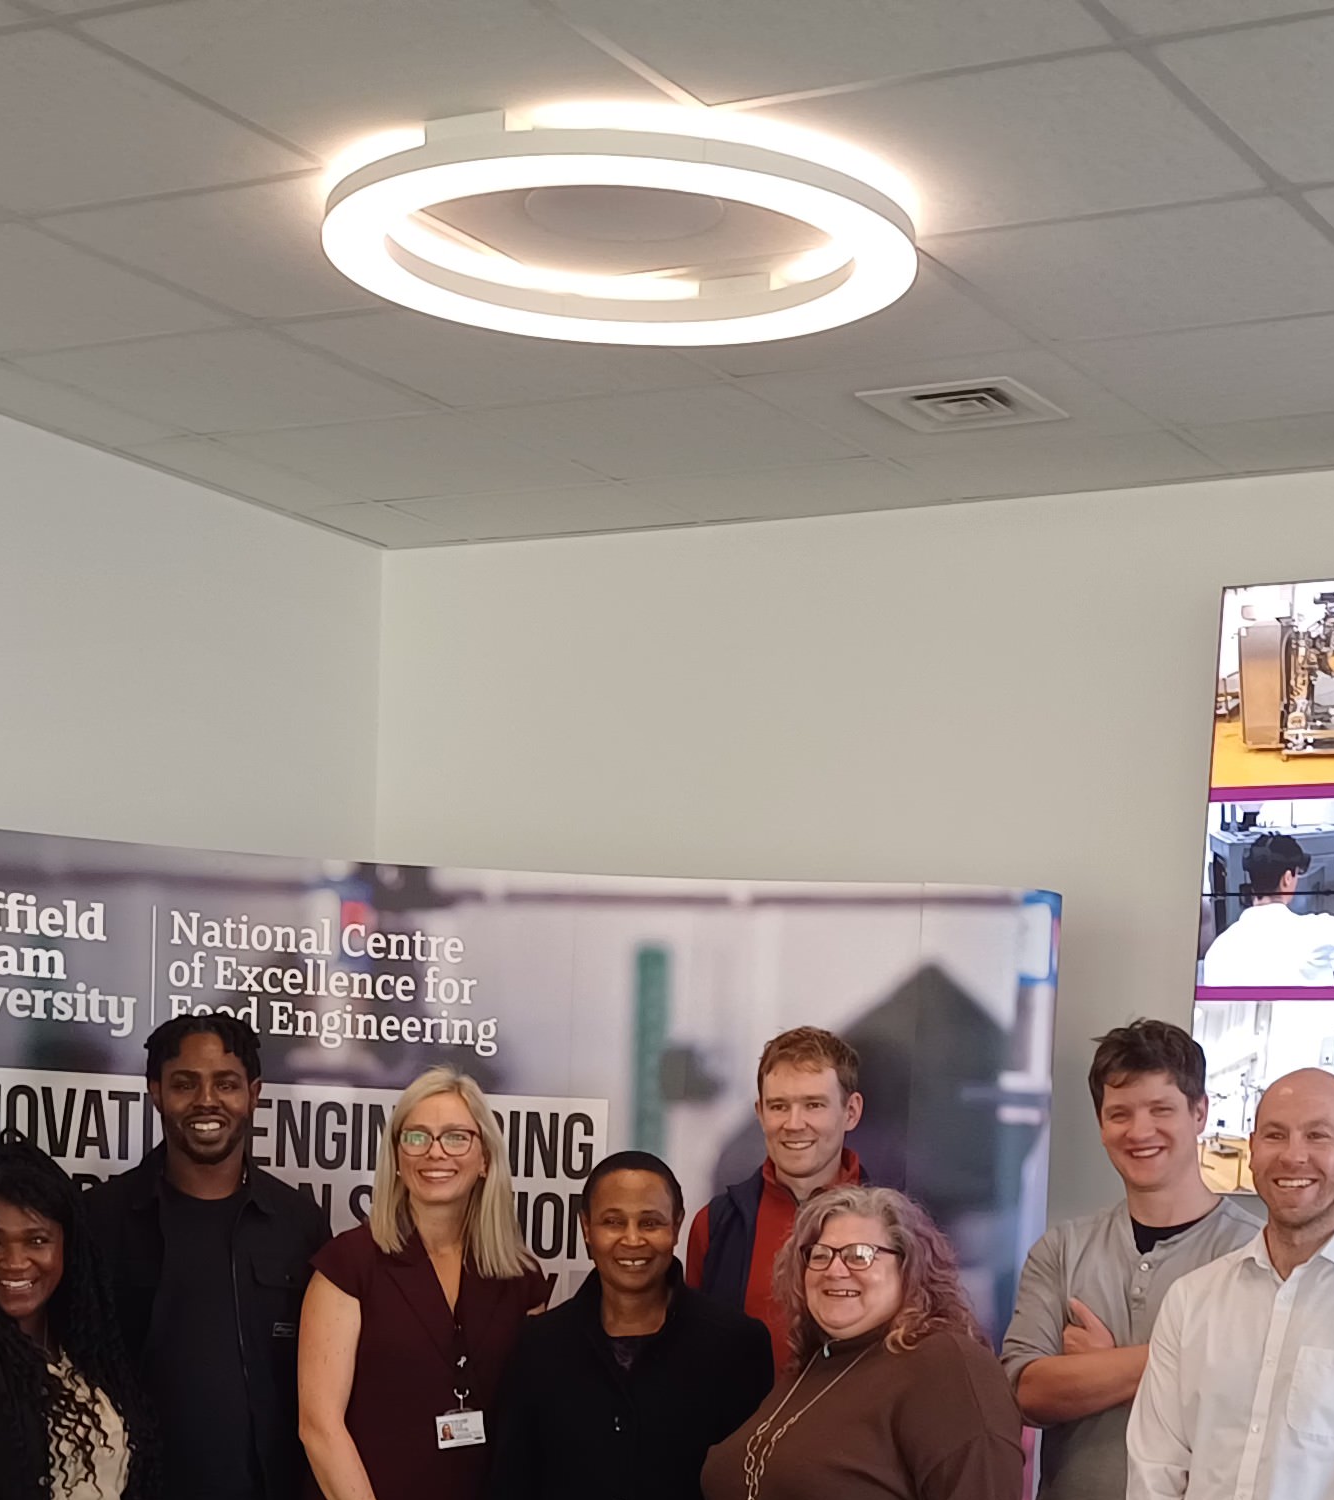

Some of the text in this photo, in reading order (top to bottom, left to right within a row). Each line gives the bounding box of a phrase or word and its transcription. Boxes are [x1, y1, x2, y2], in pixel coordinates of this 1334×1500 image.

[170, 911, 465, 963] National Centre
[168, 951, 478, 1005] of Excellence for
[269, 1000, 499, 1057] Engineering
[249, 1098, 594, 1180] ENGINING
